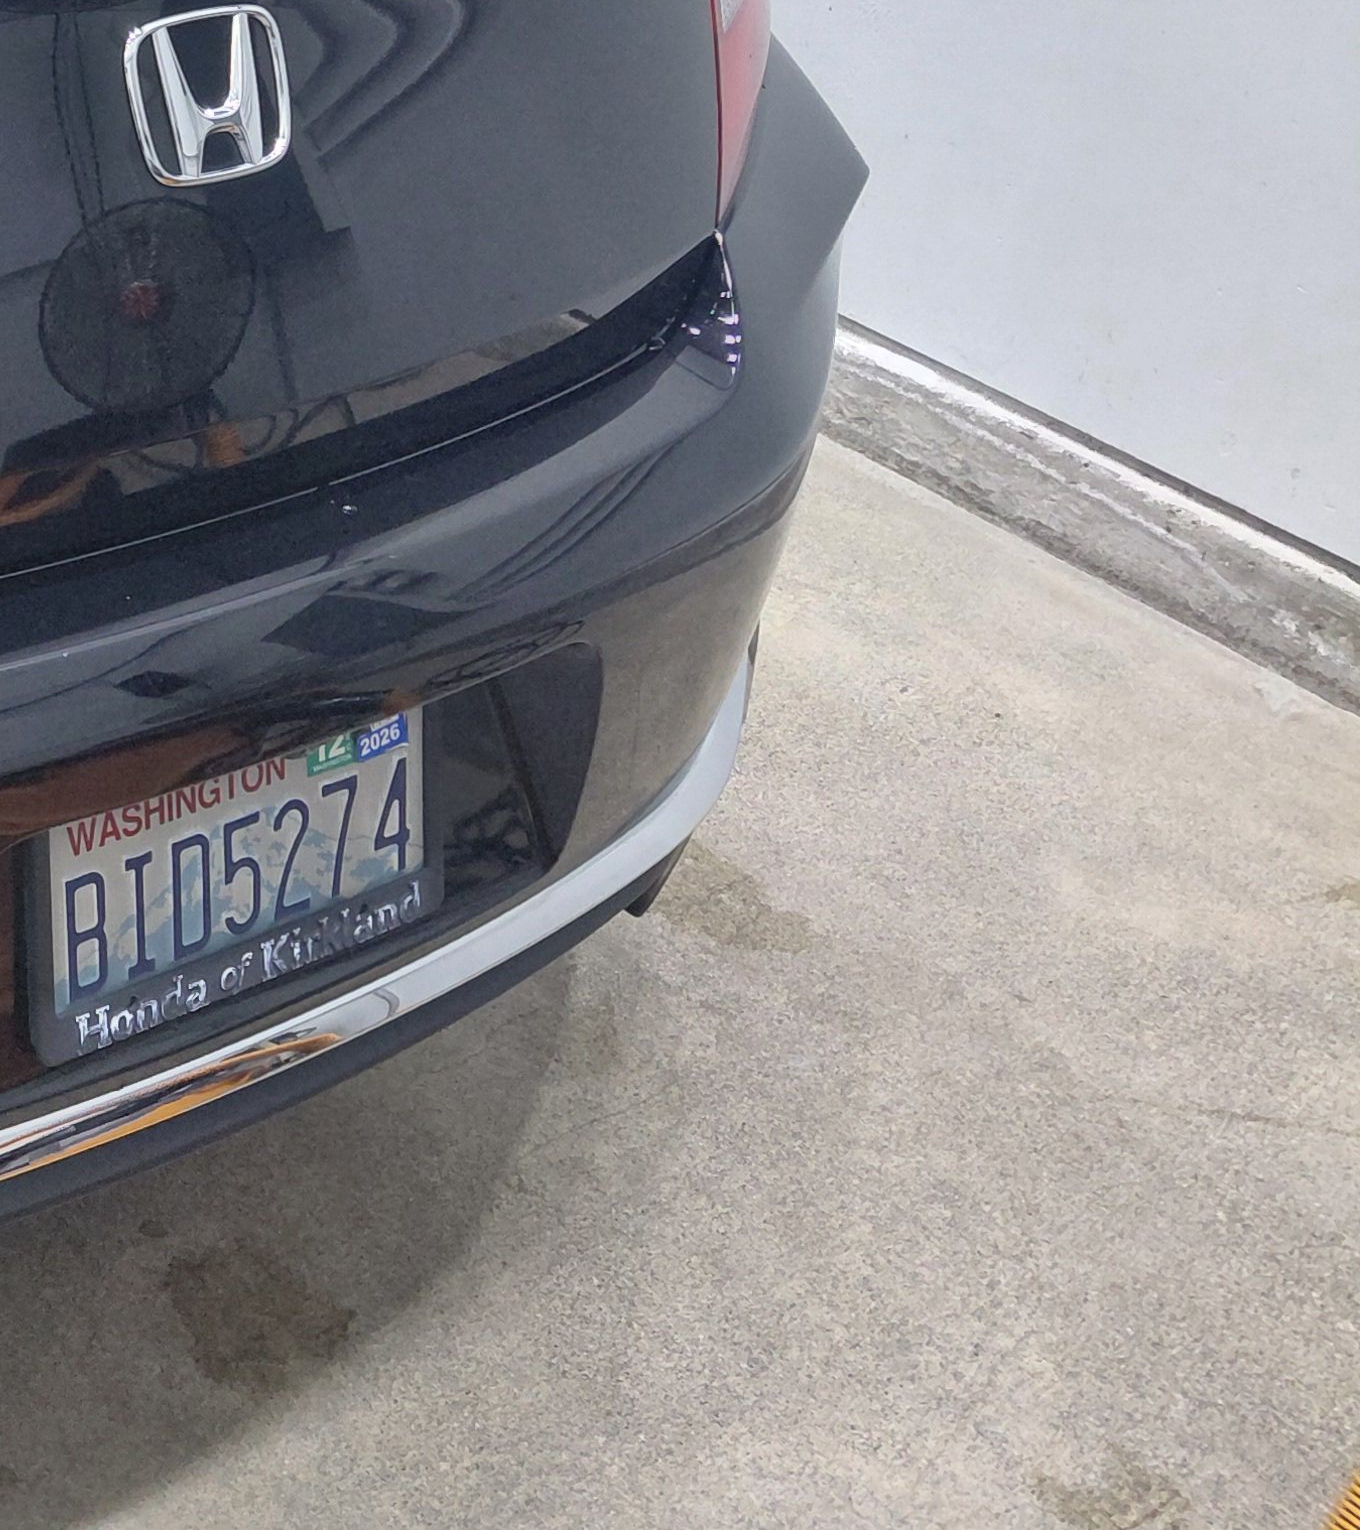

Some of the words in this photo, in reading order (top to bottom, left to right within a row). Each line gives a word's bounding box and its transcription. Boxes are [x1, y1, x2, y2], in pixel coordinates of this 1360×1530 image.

[66, 757, 286, 857] WASHINGTON
[360, 722, 401, 758] 2026
[64, 756, 410, 1001] BID5274
[76, 974, 212, 1050] Honda
[220, 951, 254, 996] of
[261, 878, 422, 983] Kirkland
